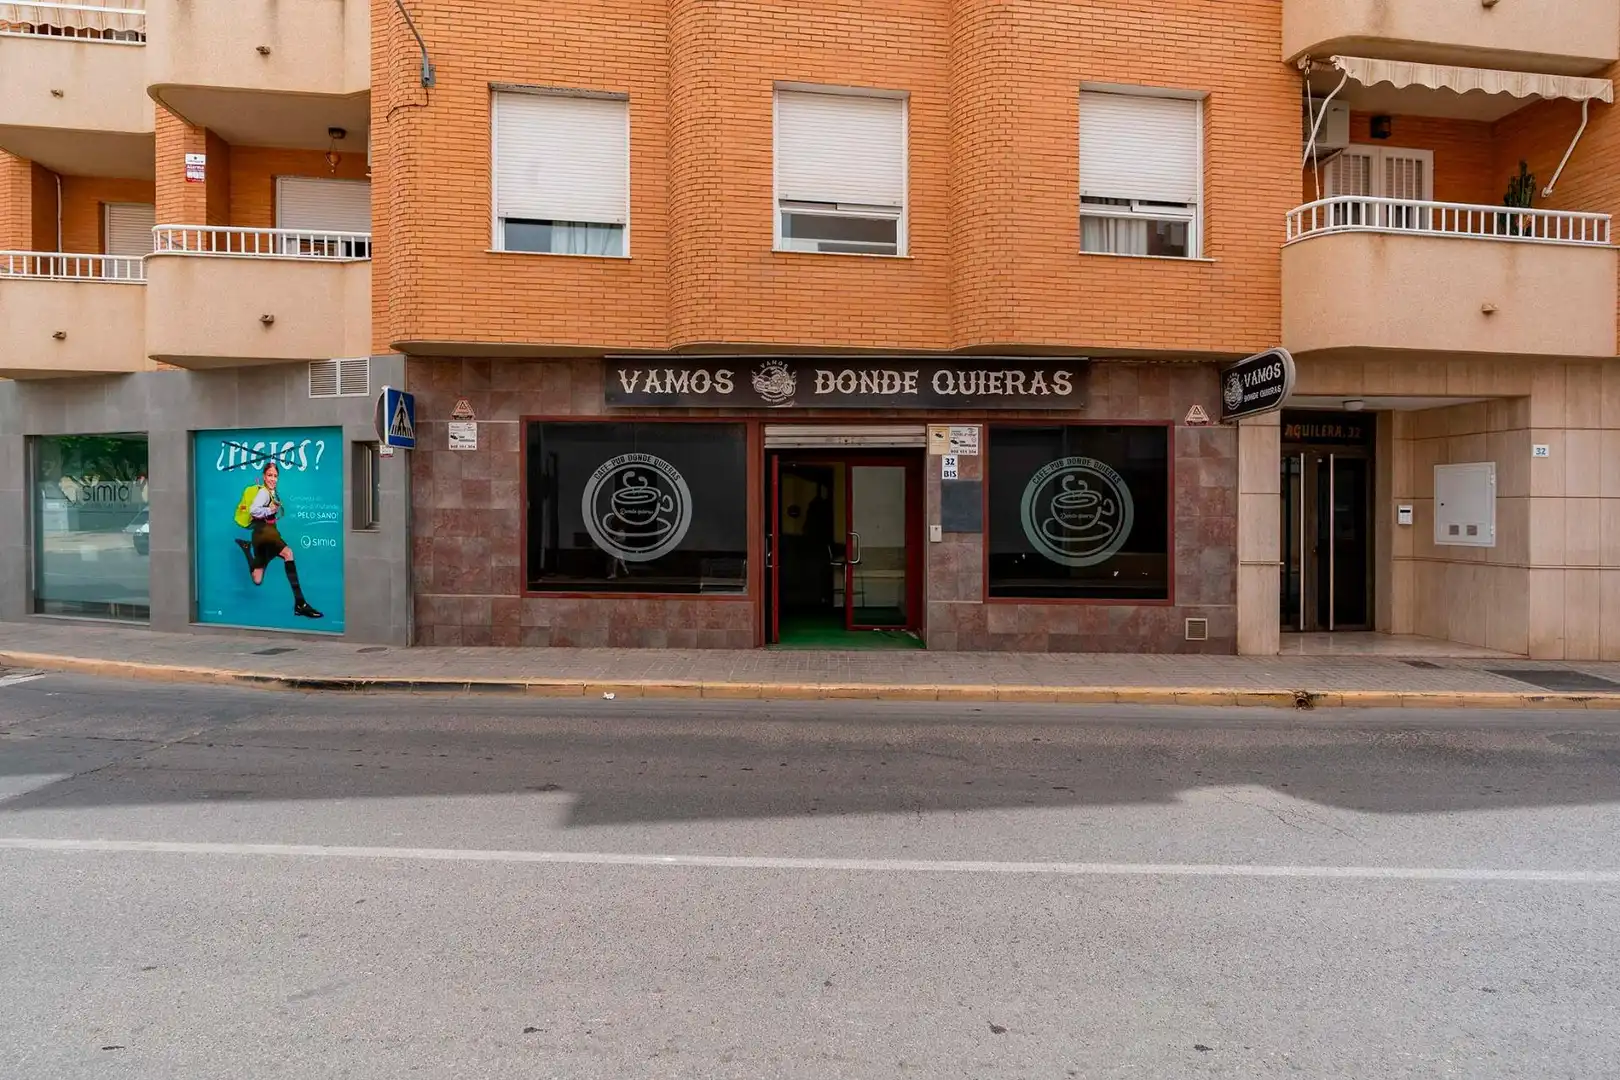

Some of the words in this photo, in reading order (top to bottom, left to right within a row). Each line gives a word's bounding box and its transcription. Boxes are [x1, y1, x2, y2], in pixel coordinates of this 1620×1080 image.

[760, 360, 789, 369] VAMOS
[1243, 362, 1282, 387] VAMOS
[617, 369, 735, 394] VAMOS
[814, 369, 919, 394] DONDE
[931, 369, 1074, 395] QUIERAS
[1535, 447, 1546, 455] 32
[944, 458, 955, 466] 32
[627, 454, 652, 463] DONDE
[653, 458, 681, 481] QUIERAS
[1066, 457, 1092, 466] DONDE
[1093, 461, 1122, 484] QUIERAS
[943, 470, 957, 478] BIS
[297, 511, 316, 519] PELO
[316, 511, 337, 519] SANO
